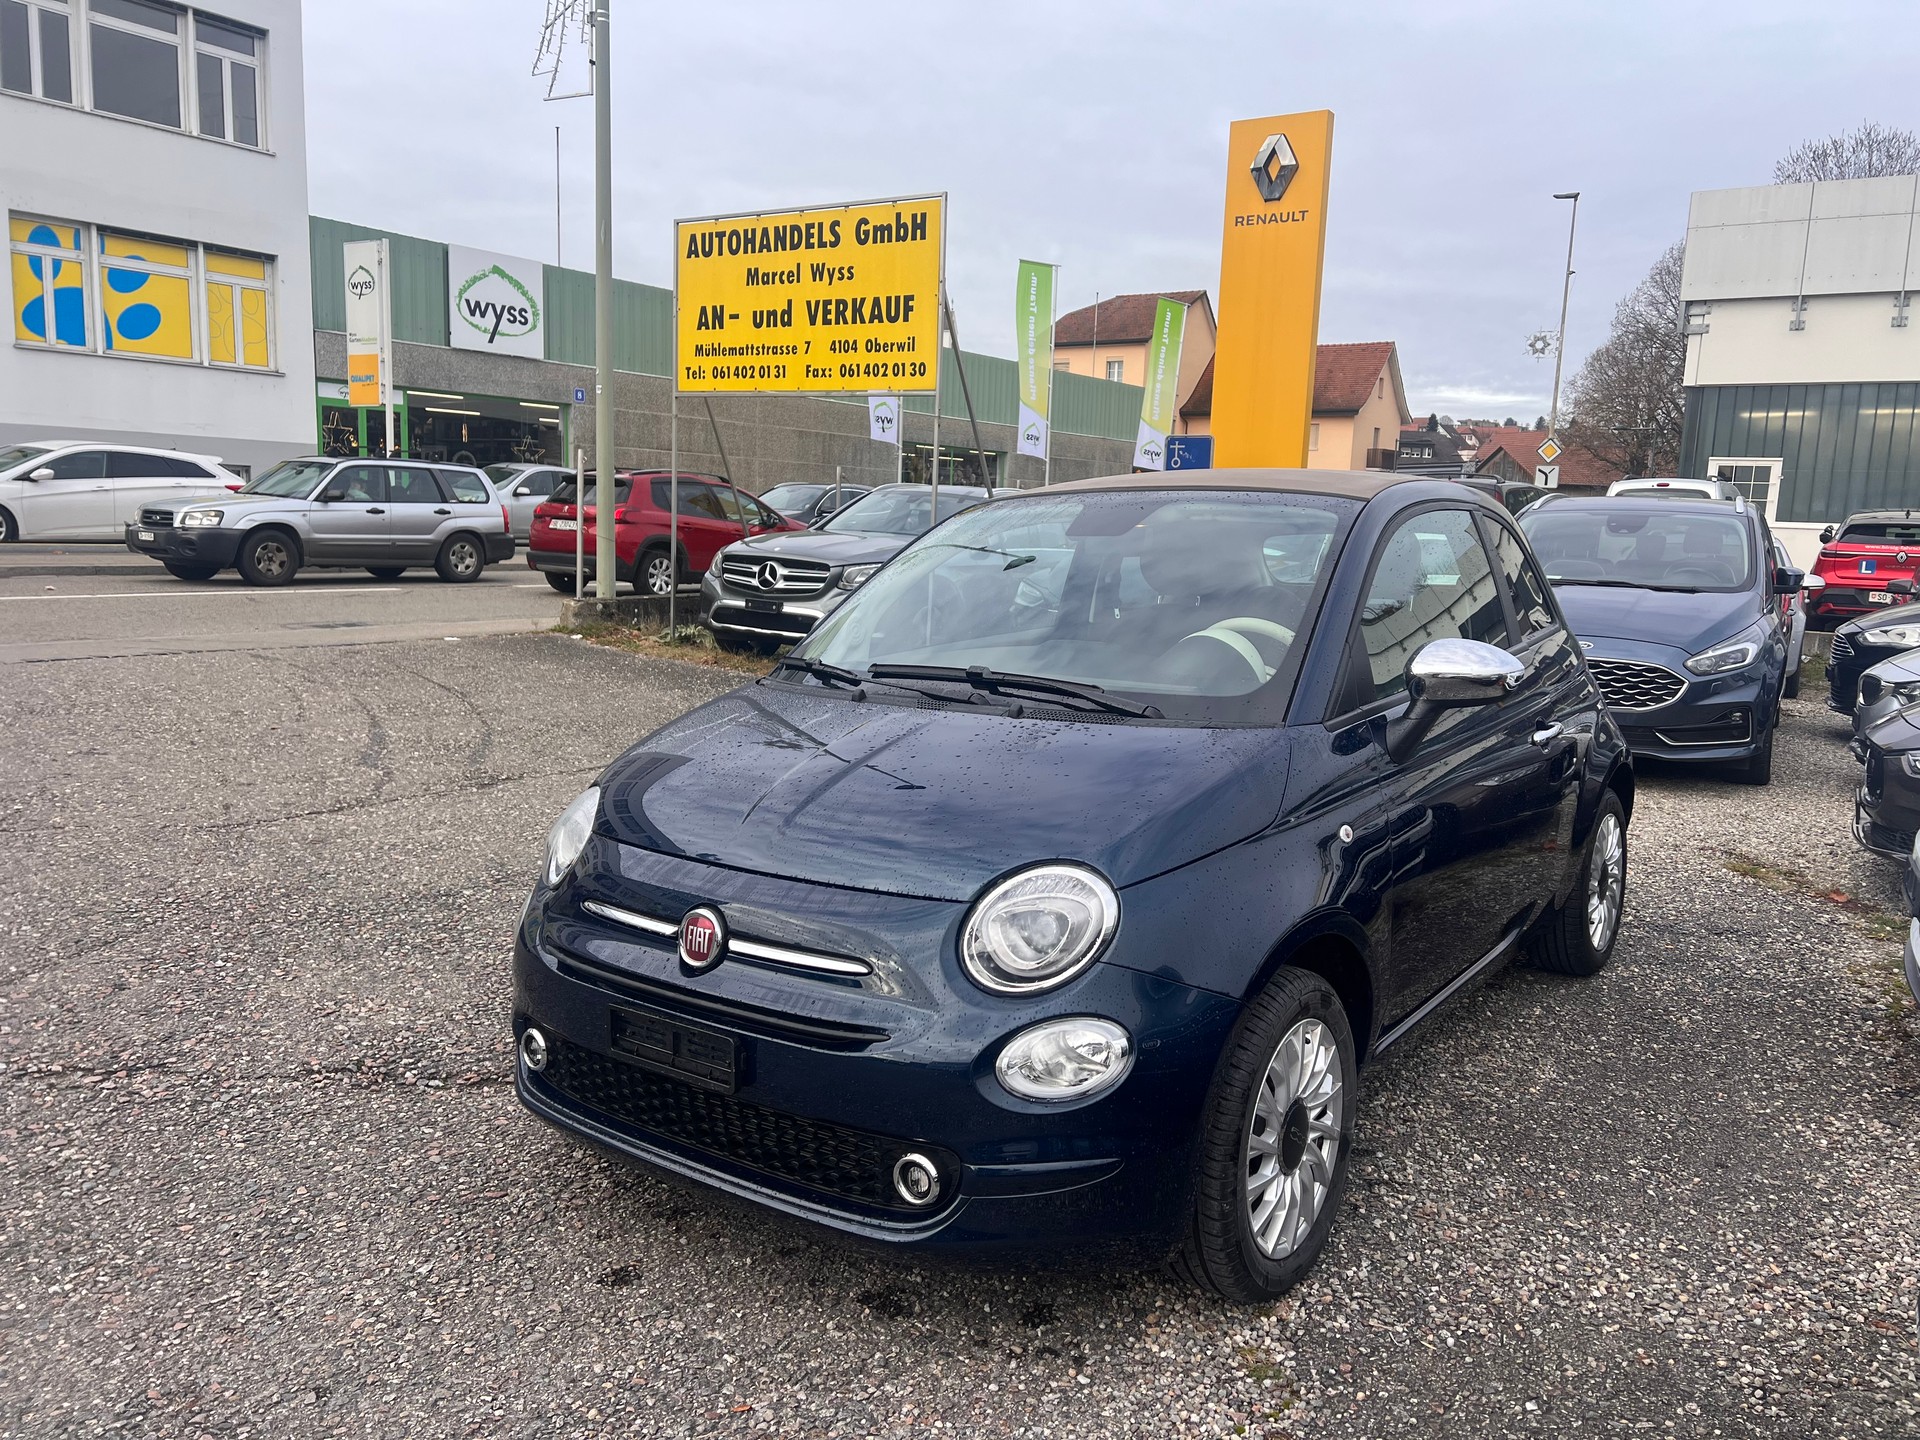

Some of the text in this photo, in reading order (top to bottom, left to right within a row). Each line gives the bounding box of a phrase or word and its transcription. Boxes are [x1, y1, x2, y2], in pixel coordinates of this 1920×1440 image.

[1234, 210, 1309, 227] RENAULT
[686, 211, 927, 259] AUTOHANDELS GmbH
[745, 262, 855, 286] Marcel Wyss
[350, 280, 372, 300] wyss
[464, 298, 529, 344] wyss
[696, 294, 915, 330] AN- und VERKAUF
[694, 336, 916, 357] Mühlemattstrasse 7 4104 Oberwil
[685, 365, 706, 380] Tel:
[805, 364, 832, 378] Fax:
[1861, 560, 1872, 574] L
[686, 925, 712, 954] FIAT
